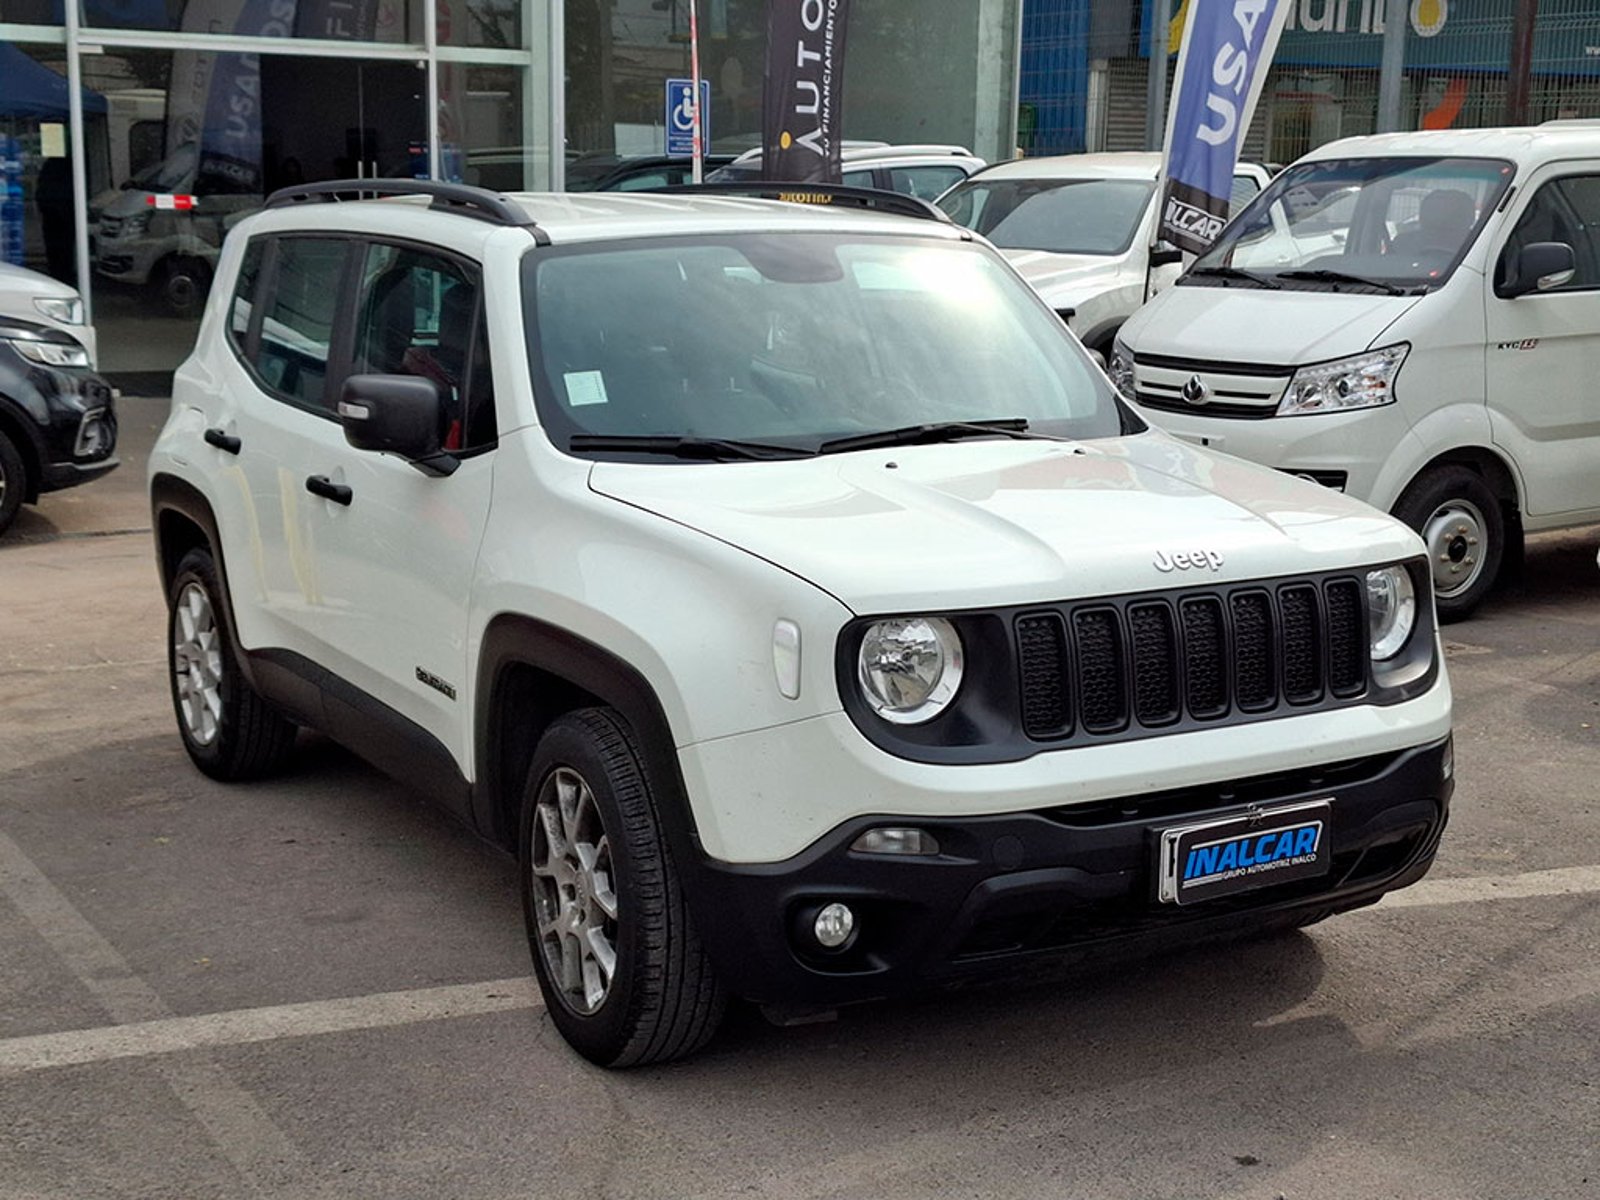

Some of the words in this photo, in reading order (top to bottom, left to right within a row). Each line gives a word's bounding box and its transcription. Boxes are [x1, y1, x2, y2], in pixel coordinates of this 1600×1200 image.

[822, 0, 838, 132] FINANCIAMIENTO
[1152, 547, 1225, 573] Jeep
[1184, 827, 1316, 879] INALCAR
[1223, 868, 1246, 880] GRUPO
[1292, 853, 1317, 865] INALCO
